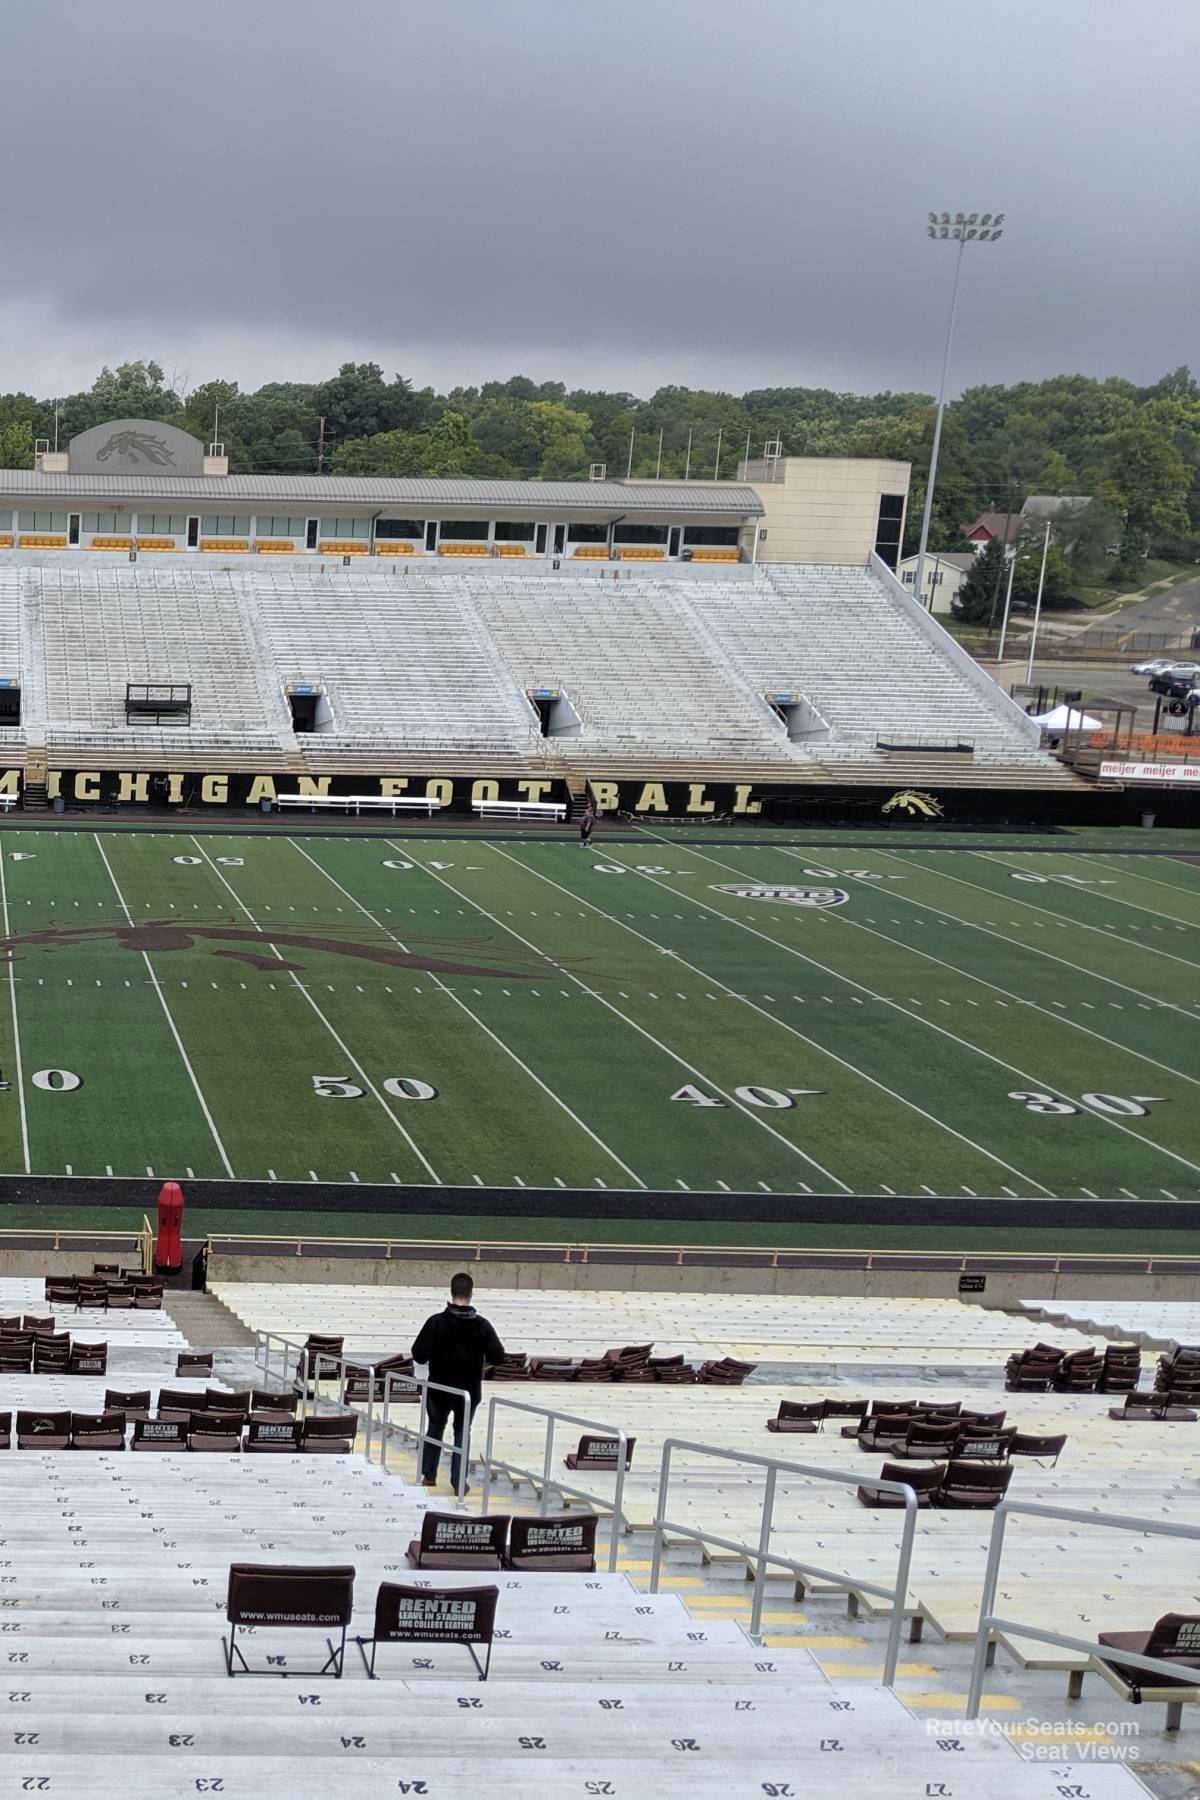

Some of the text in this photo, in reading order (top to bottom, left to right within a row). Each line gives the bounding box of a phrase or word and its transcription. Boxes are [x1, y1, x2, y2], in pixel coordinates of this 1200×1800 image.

[1102, 763, 1136, 775] meijer
[1143, 764, 1177, 777] meijer
[311, 1076, 437, 1100] 50
[670, 1083, 796, 1109] 40
[1007, 1091, 1150, 1116] 30
[437, 1523, 494, 1534] RENTED
[528, 1527, 583, 1537] RENTED
[400, 1599, 476, 1614] RENTED
[240, 1611, 340, 1622] www.wmuseats.com
[399, 1612, 429, 1620] LEAVE
[439, 1613, 475, 1622] STADIUM
[399, 1620, 474, 1630] IMG COLLEGE SEATING
[390, 1630, 481, 1639] www.wmuseats.com
[8, 1652, 29, 1663] 22
[129, 1654, 151, 1665] 23
[265, 1655, 288, 1667] 24
[411, 1658, 435, 1670] 25
[667, 1661, 688, 1672] 27
[8, 1691, 32, 1702] 22
[144, 1693, 168, 1704] 23
[297, 1694, 322, 1706] 24
[456, 1697, 484, 1709] 25
[734, 1700, 756, 1711] 27
[13, 1732, 40, 1745] 22
[168, 1734, 196, 1748] 23
[340, 1735, 367, 1749] 24
[517, 1736, 547, 1750] 25
[820, 1739, 845, 1752] 27
[21, 1776, 51, 1791] 22
[195, 1777, 225, 1794] 23
[397, 1780, 429, 1795] 24
[584, 1781, 616, 1796] 25
[925, 1783, 953, 1797] 27
